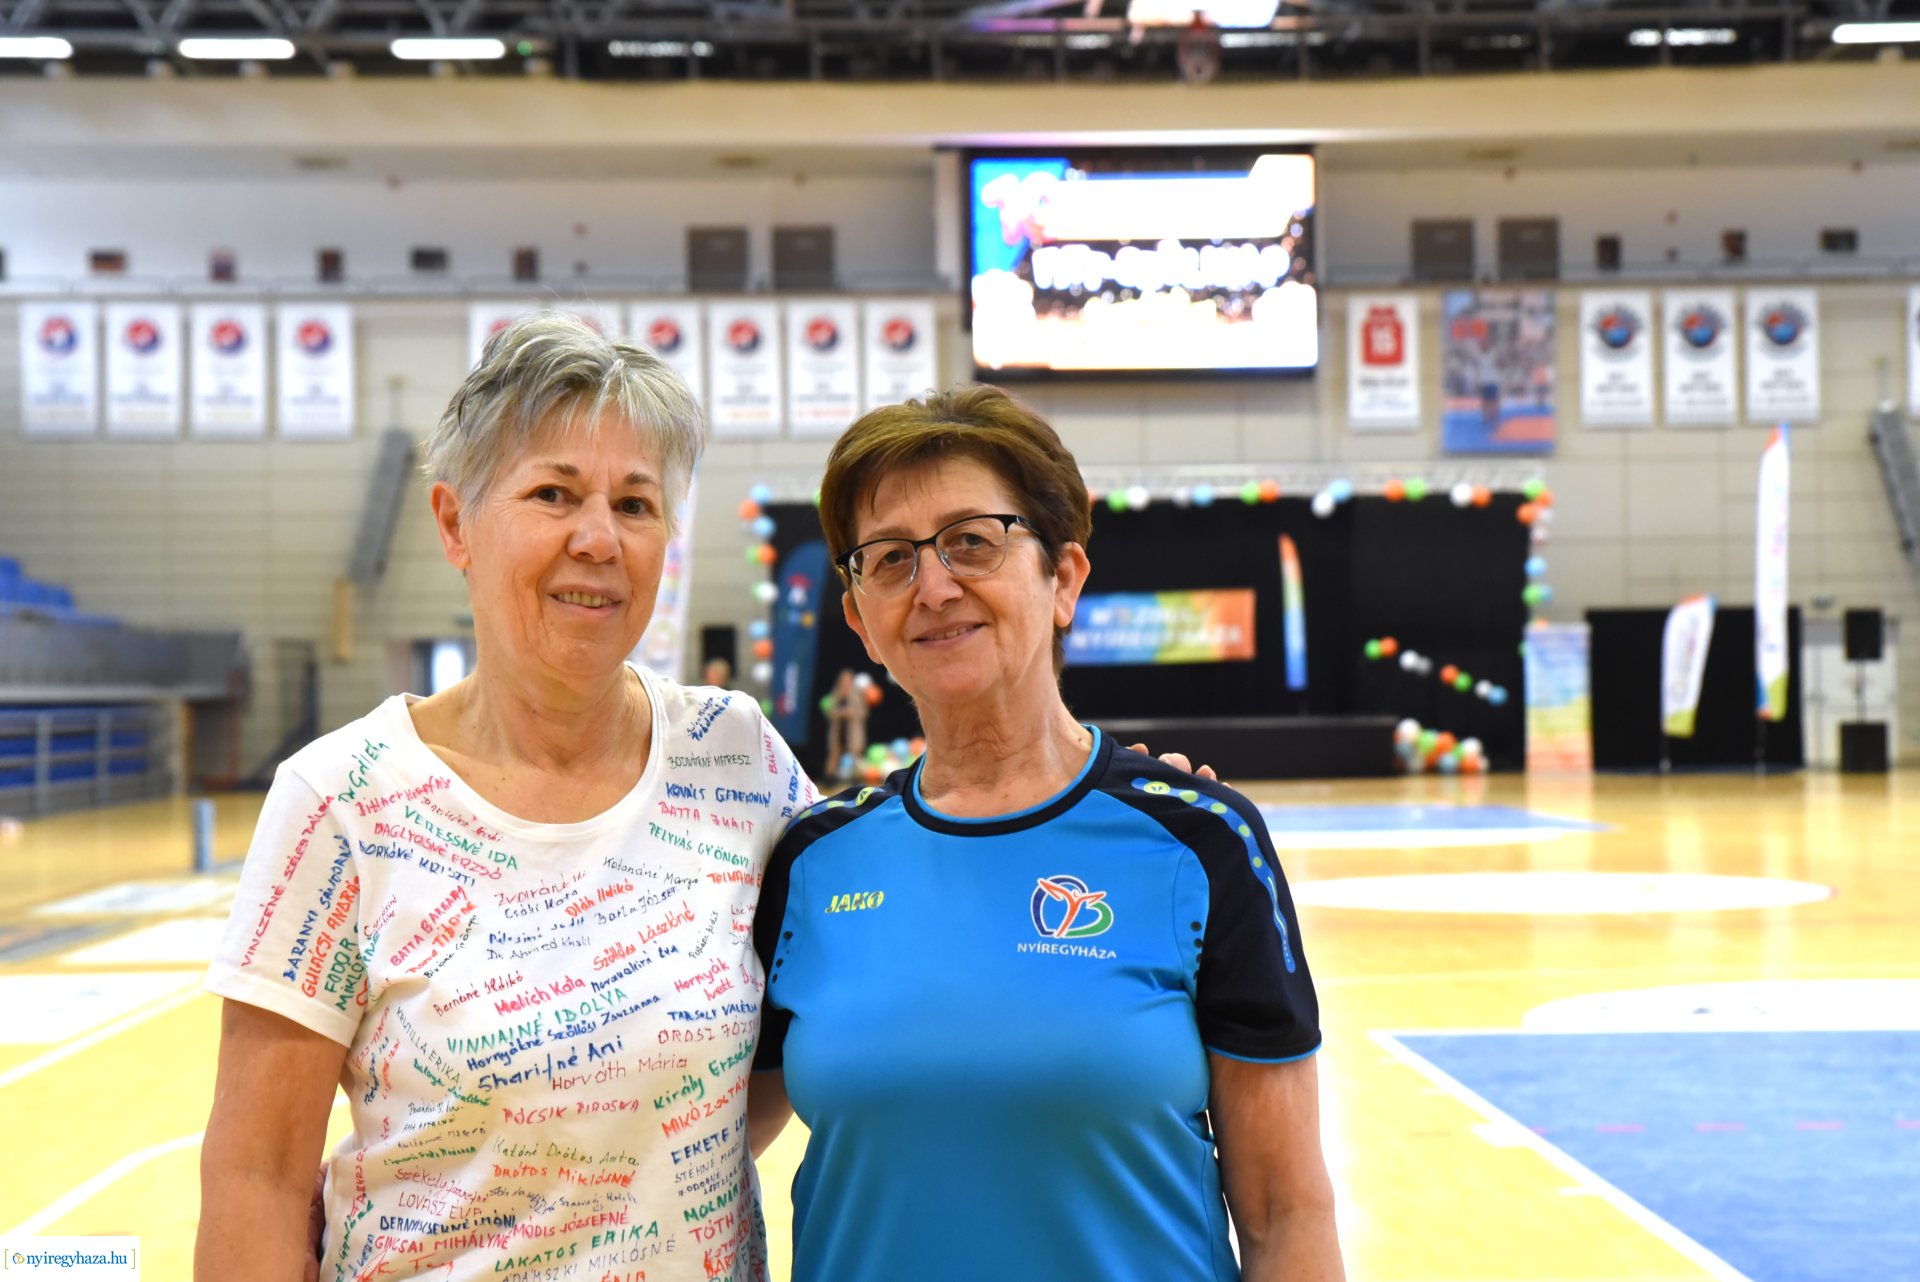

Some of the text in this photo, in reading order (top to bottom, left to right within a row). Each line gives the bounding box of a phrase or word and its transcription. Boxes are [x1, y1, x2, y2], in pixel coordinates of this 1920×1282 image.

[488, 850, 518, 870] IDA
[825, 890, 885, 914] JAKO
[1017, 941, 1118, 960] NYÍREGYHÁZA
[552, 1058, 627, 1092] Horváth
[494, 1220, 659, 1272] LAKATOS ERIKA
